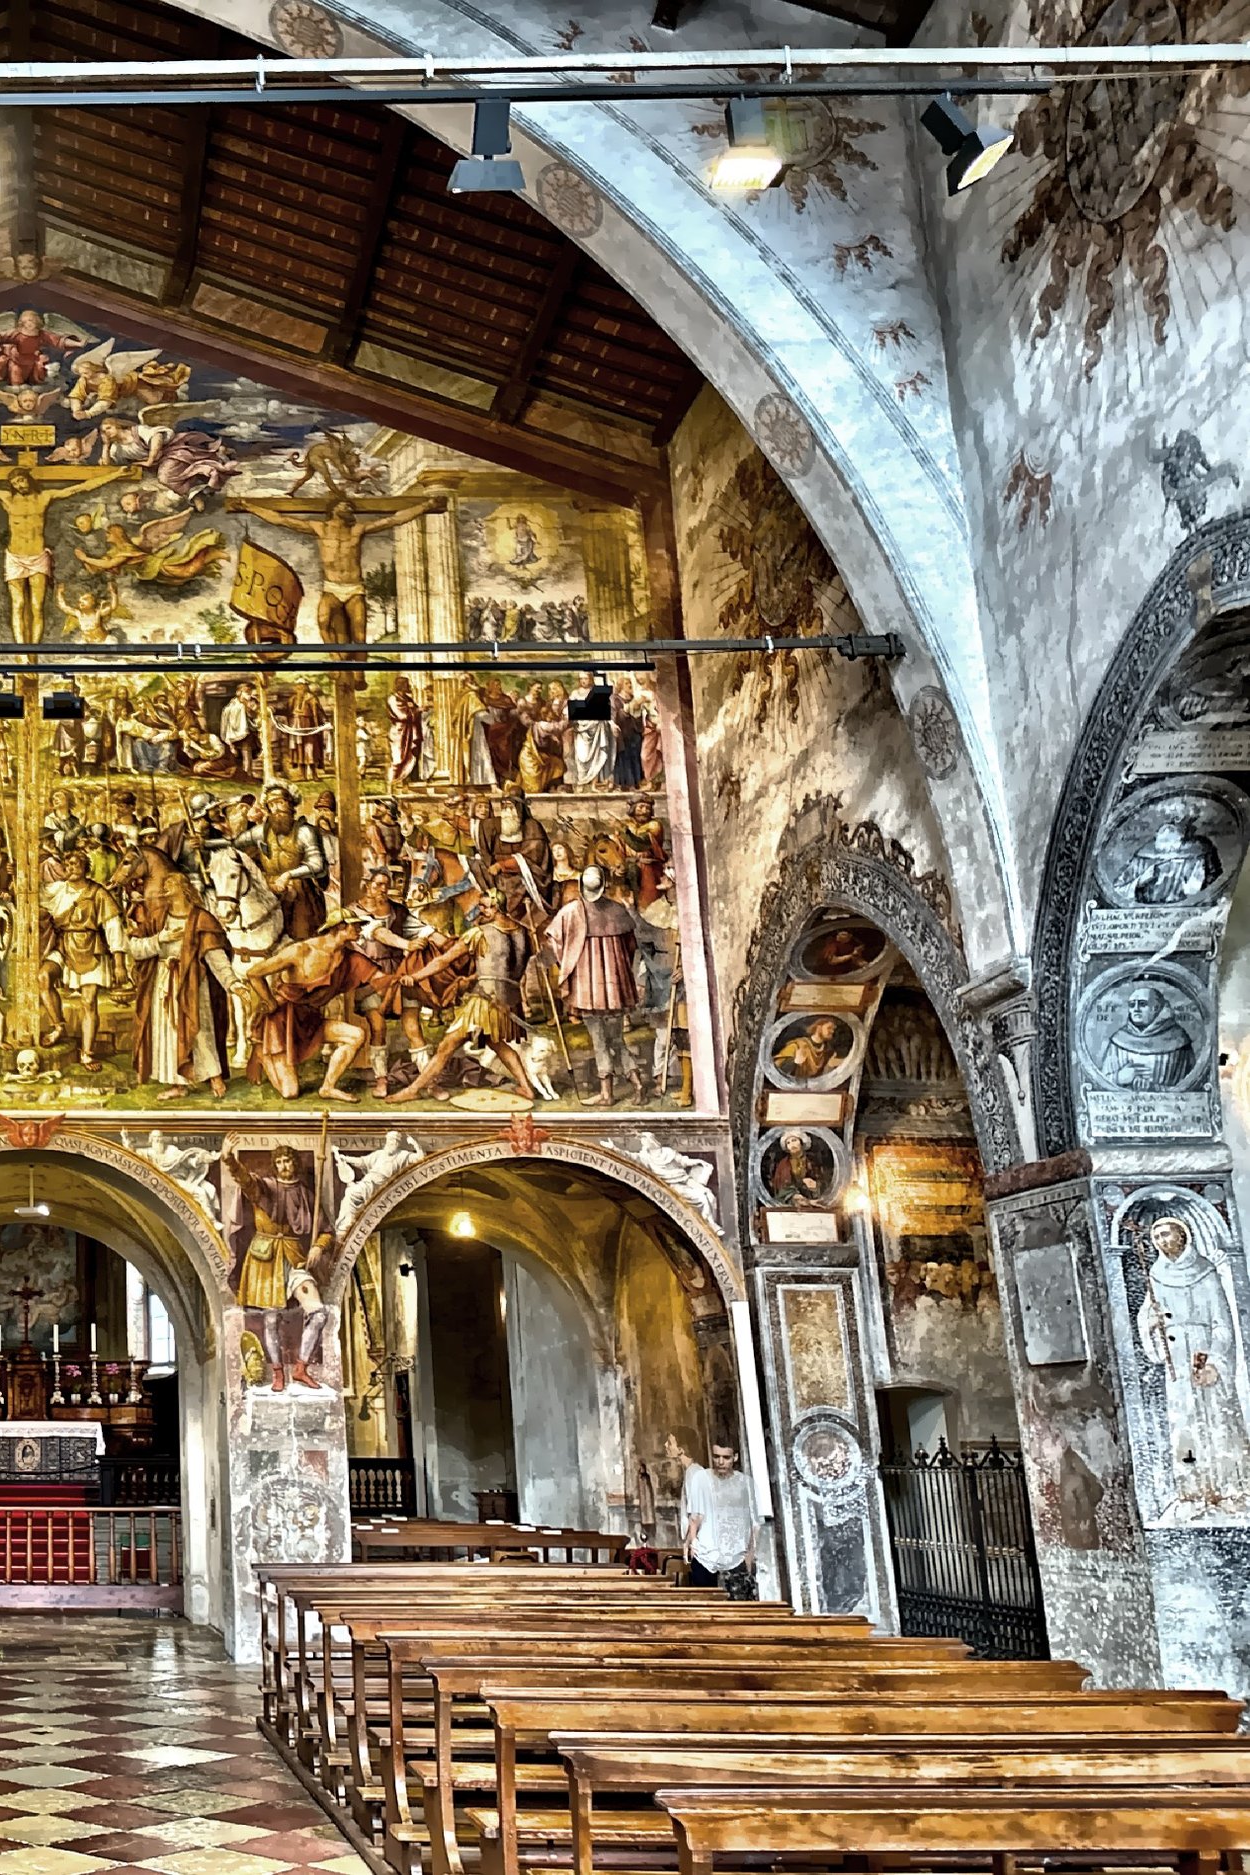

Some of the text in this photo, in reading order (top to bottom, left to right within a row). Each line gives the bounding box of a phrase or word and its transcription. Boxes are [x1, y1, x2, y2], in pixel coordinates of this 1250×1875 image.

[421, 1146, 503, 1179] VESTIMENTA
[545, 1145, 607, 1169] ASPICIENT
[608, 1162, 623, 1176] IN
